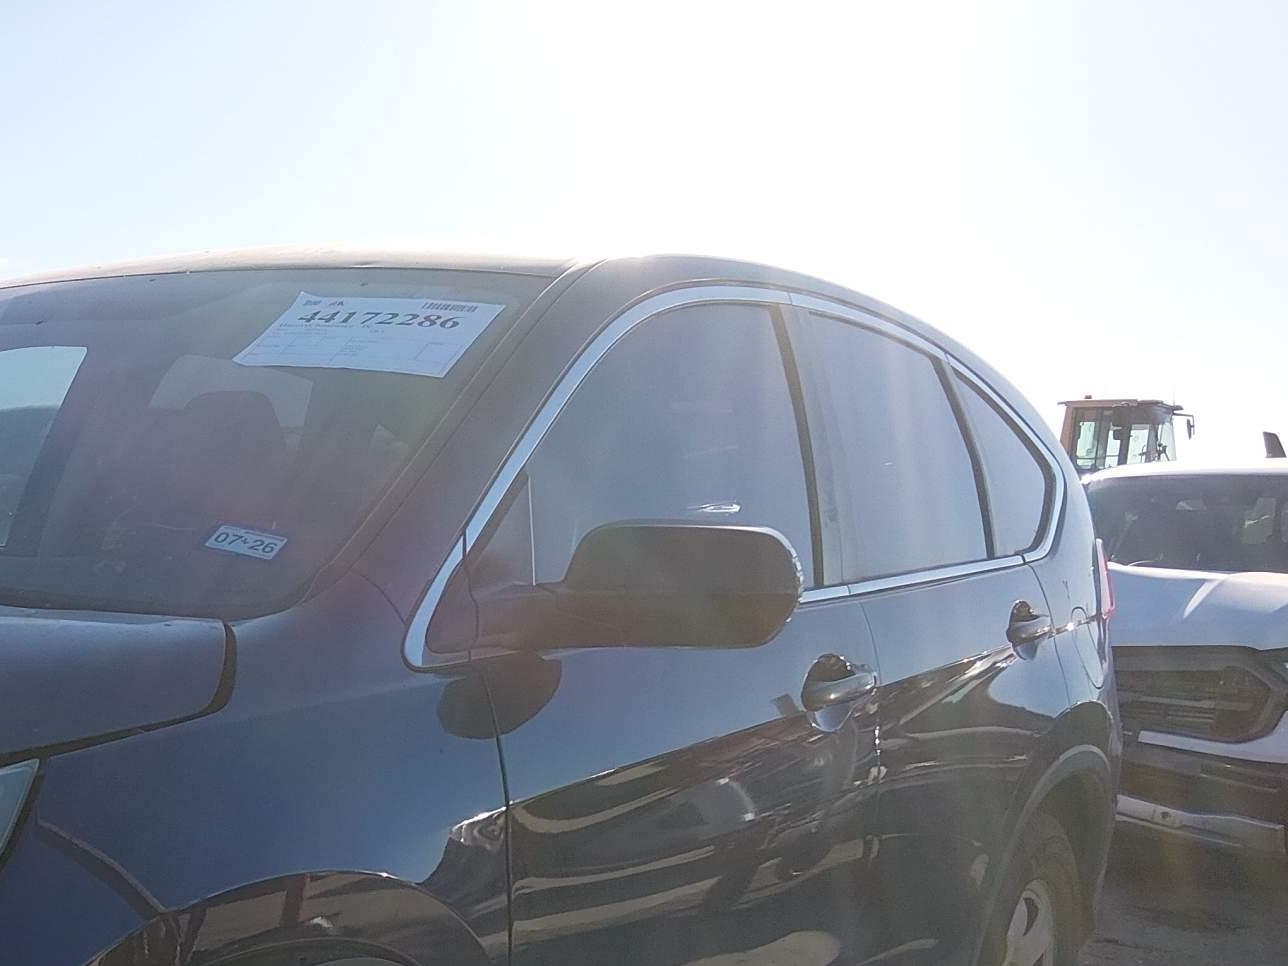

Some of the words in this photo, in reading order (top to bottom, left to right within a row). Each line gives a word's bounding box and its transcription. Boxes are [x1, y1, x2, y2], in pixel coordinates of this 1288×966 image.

[297, 310, 464, 330] 44172286
[214, 532, 244, 545] 07
[248, 539, 278, 554] 26
